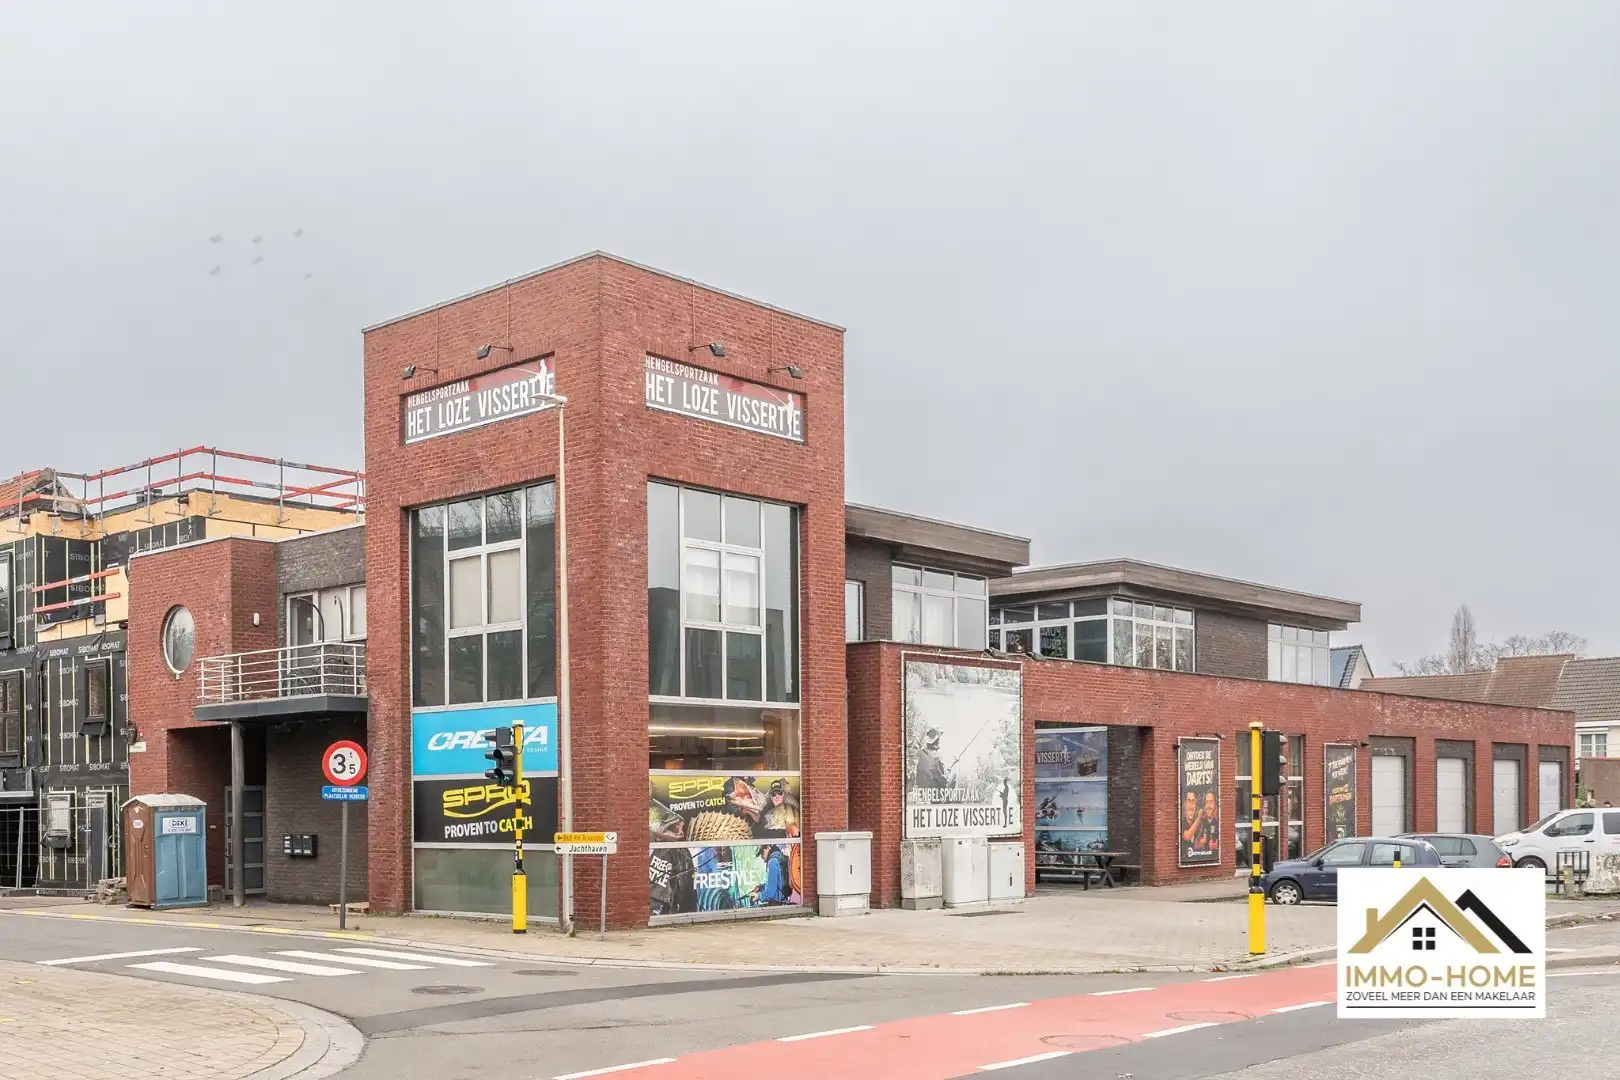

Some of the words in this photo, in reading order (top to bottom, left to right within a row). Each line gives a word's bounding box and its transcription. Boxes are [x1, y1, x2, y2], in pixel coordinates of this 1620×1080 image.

[646, 356, 719, 386] HENGELSPORTZAAK
[407, 380, 470, 409] HENGELSPORTZAAK
[646, 372, 675, 405] HET
[682, 382, 719, 416] LOZE
[407, 407, 432, 437] HET
[438, 395, 472, 429] LOZE
[427, 726, 548, 751] CREA
[333, 753, 346, 774] 3
[349, 763, 356, 774] 5
[1205, 750, 1212, 760] DE
[668, 777, 725, 793] SPRO
[1186, 770, 1213, 786] DARTS!
[669, 801, 696, 812] PROVEN
[695, 800, 705, 810] TO
[705, 797, 725, 807] CATCH
[912, 787, 980, 802] HENGELSPORTZAAK
[444, 822, 483, 839] PROVEN
[483, 820, 498, 834] TO
[499, 816, 533, 833] CATH
[912, 808, 932, 828] HET
[935, 808, 959, 828] LOZE
[568, 844, 608, 853] Jachthaven
